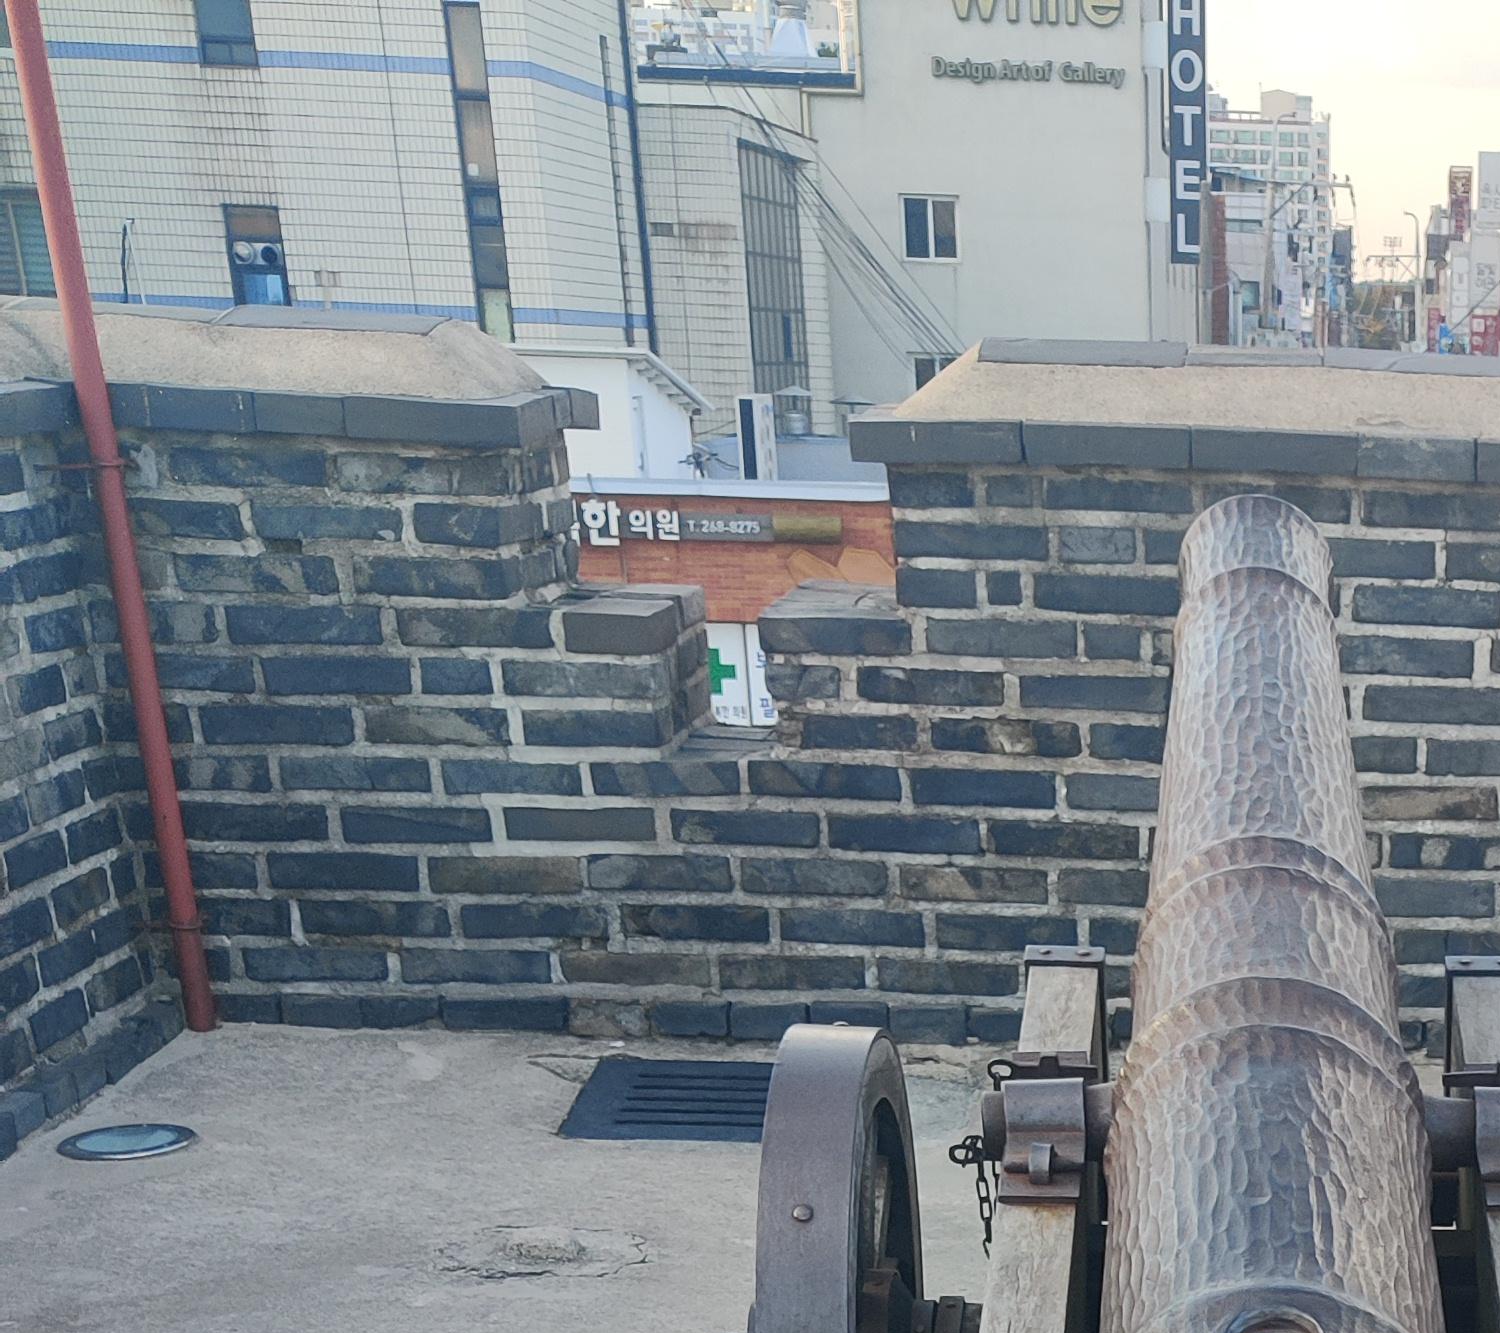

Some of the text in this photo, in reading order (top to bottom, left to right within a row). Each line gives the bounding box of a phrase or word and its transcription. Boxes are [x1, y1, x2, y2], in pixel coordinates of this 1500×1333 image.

[931, 55, 1126, 89] Design Art of Gallery
[1171, 0, 1203, 253] HOTEL
[571, 499, 680, 546] 한의원
